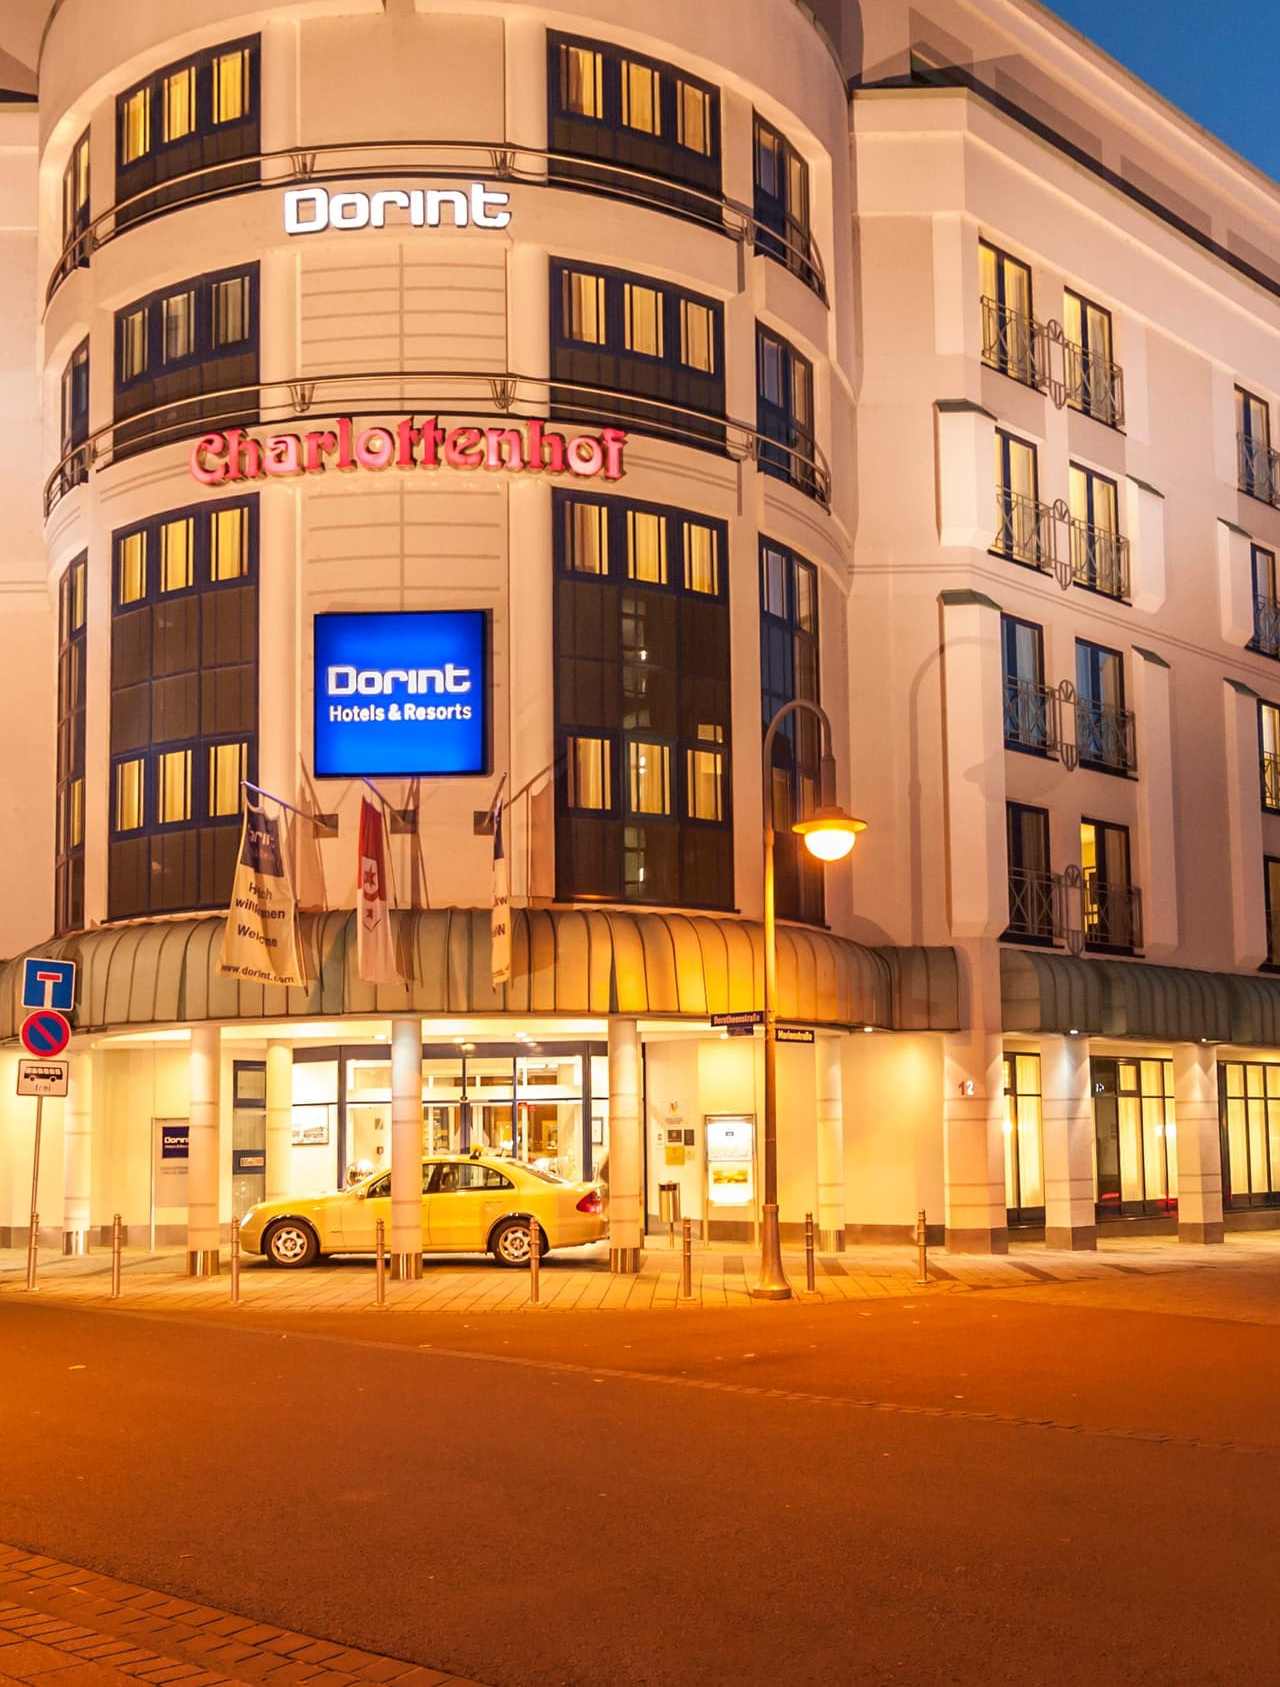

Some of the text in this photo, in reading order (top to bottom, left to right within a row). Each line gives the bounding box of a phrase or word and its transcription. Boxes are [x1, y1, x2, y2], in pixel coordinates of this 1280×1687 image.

[284, 183, 511, 234] Dorint
[189, 416, 627, 485] Charlottenhof
[327, 664, 471, 696] Dorint
[329, 702, 472, 722] Hotels & Resorts
[958, 1080, 974, 1096] 12
[164, 1136, 188, 1145] Dorin
